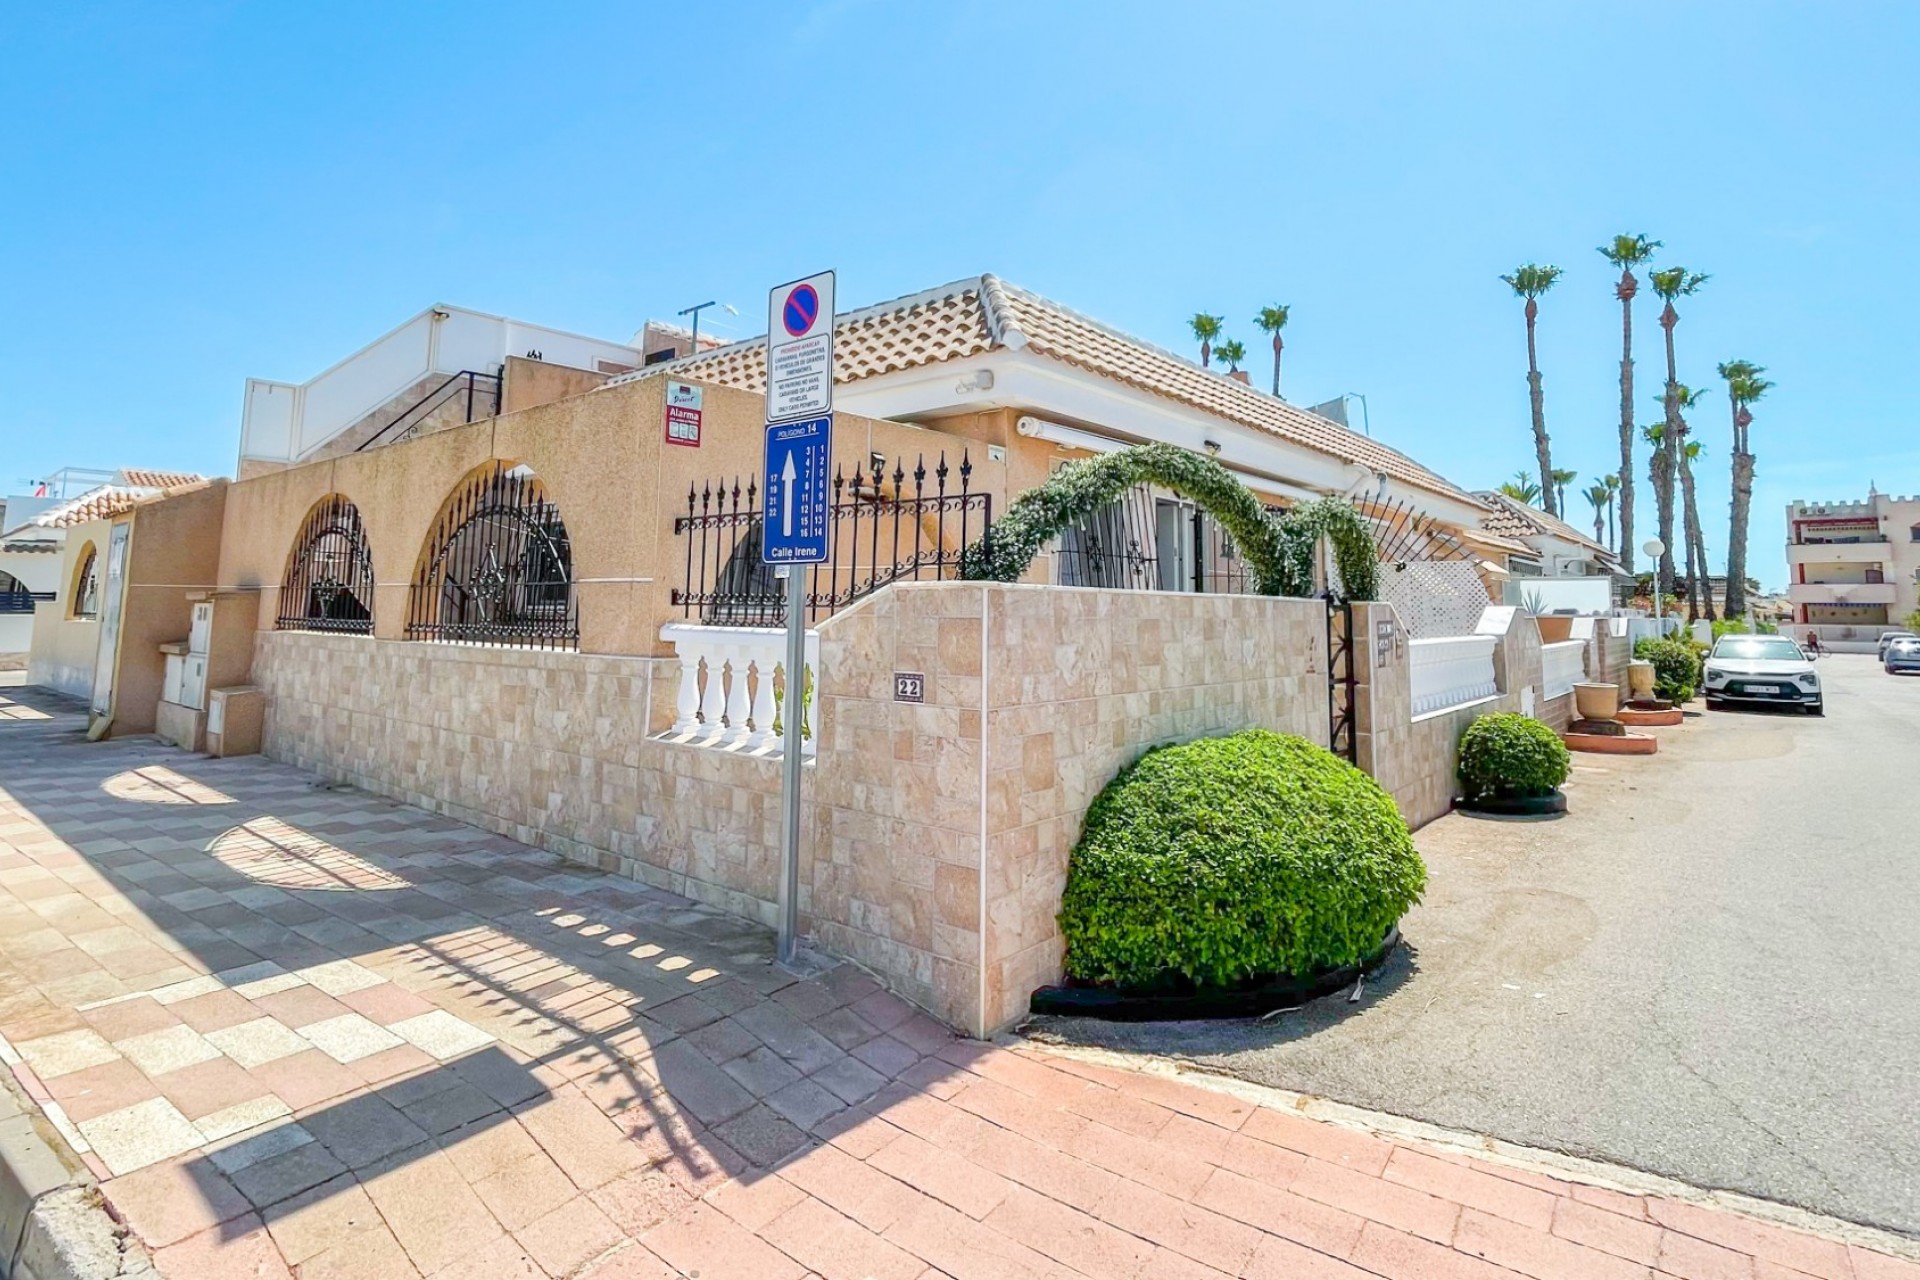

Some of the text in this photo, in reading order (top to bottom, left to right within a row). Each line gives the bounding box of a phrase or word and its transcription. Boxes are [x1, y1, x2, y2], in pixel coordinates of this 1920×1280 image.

[670, 408, 699, 420] Alarma
[808, 422, 816, 433] 14
[806, 446, 810, 455] 3
[821, 445, 824, 453] 1
[806, 458, 810, 466] 4
[820, 456, 824, 465] 2
[819, 468, 824, 476] 5
[770, 474, 778, 482] 17
[819, 480, 823, 488] 6
[819, 492, 823, 500] 9
[801, 505, 808, 513] 12
[815, 504, 823, 512] 10
[801, 517, 808, 525] 15
[815, 516, 822, 524] 13
[814, 528, 822, 536] 14
[771, 547, 817, 557] Calle Irene
[900, 680, 918, 695] 22
